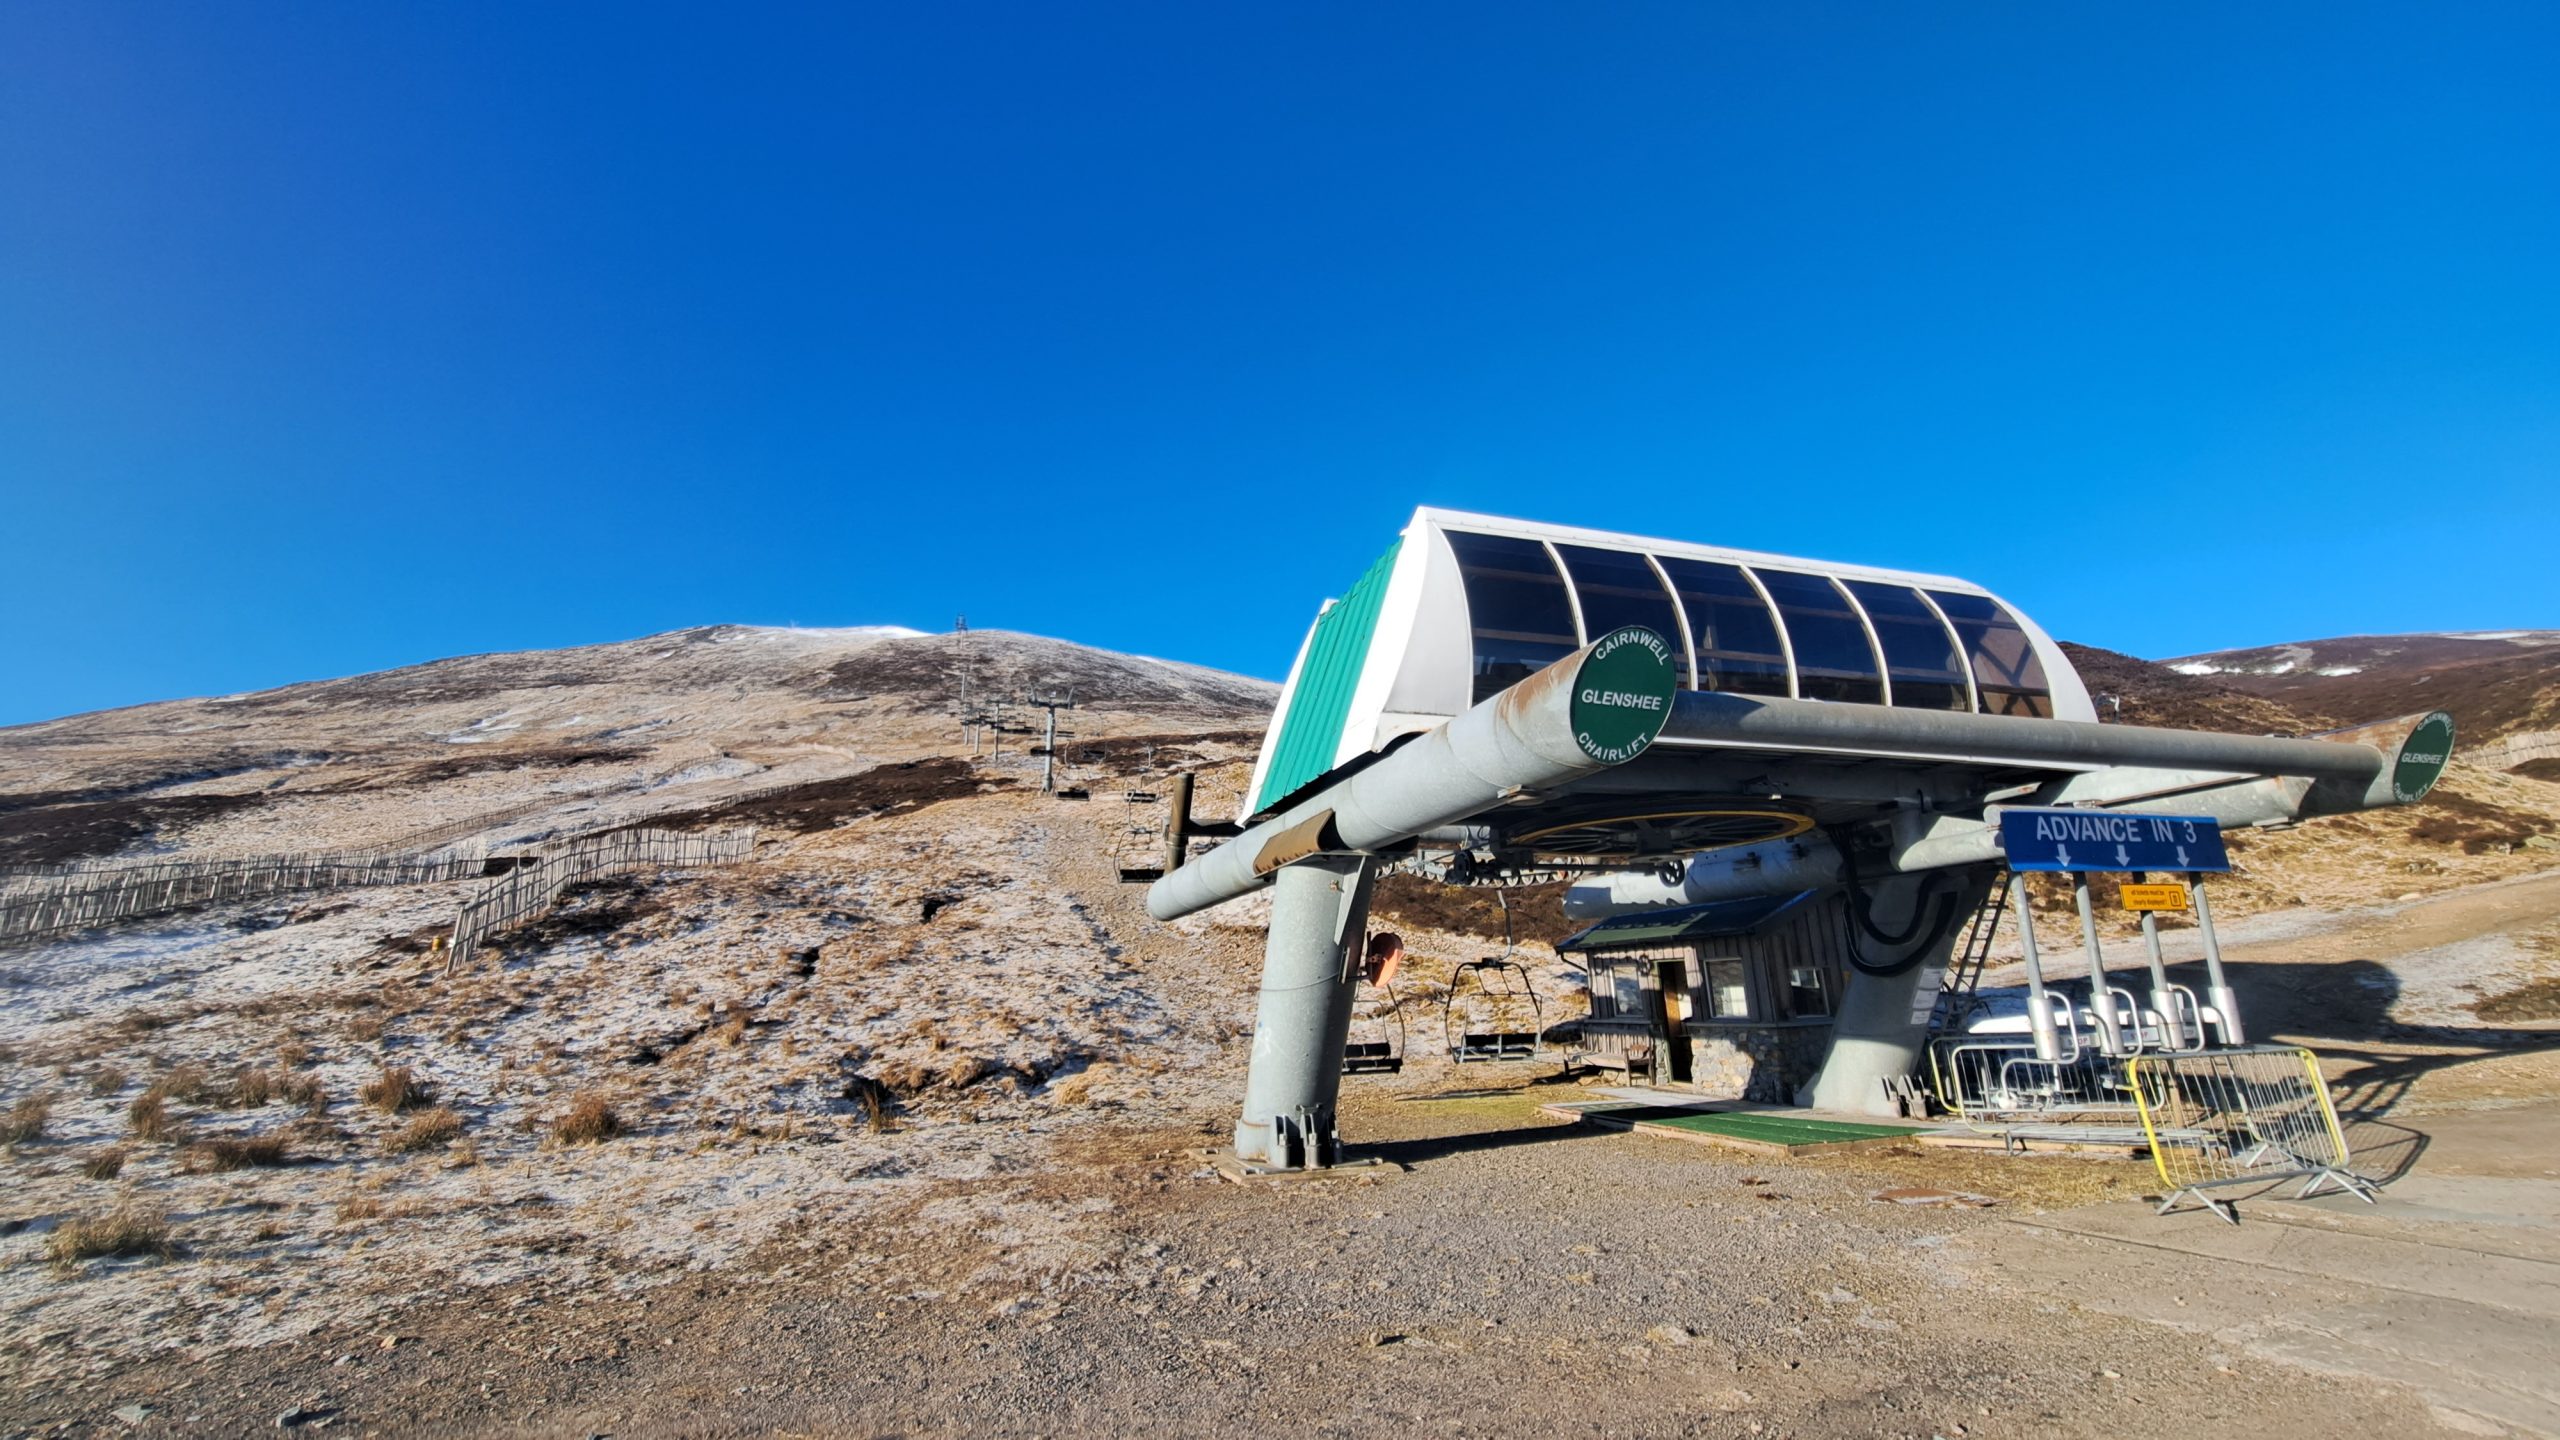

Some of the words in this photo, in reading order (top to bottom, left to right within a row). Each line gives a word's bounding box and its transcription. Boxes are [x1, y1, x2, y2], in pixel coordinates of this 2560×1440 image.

[1596, 631, 1669, 666] CAIRNWELL
[1582, 689, 1662, 710] GLENSHEE
[1578, 732, 1649, 761] CHAIRLIFT
[2402, 753, 2443, 764] GLENSHEE
[2036, 816, 2142, 842] ADVANCE
[2151, 818, 2174, 842] IN
[2184, 821, 2197, 844] 3
